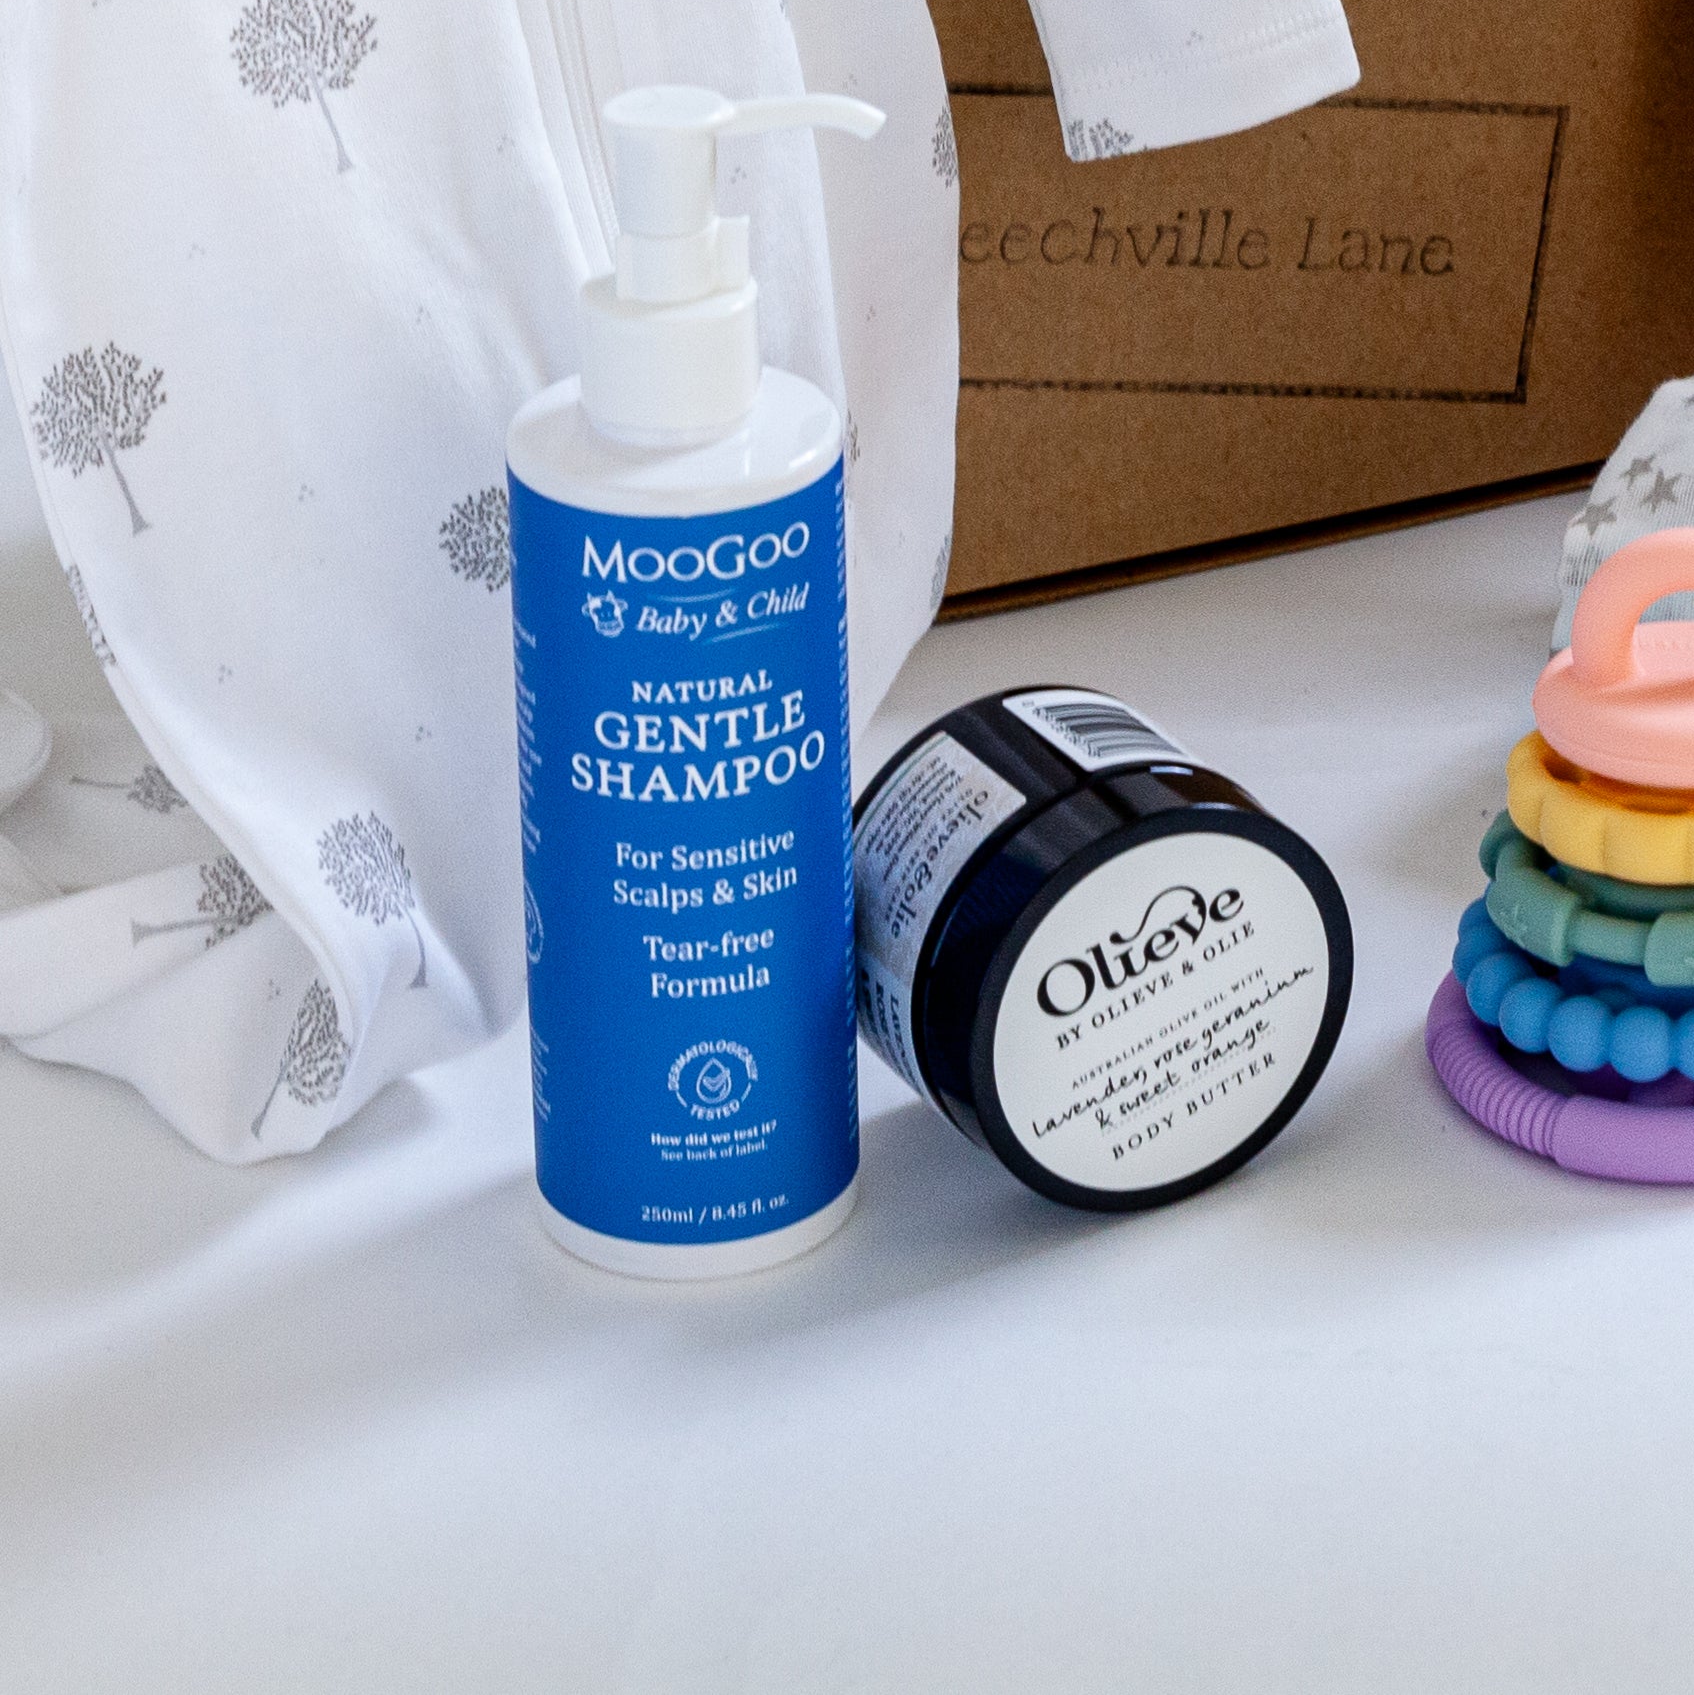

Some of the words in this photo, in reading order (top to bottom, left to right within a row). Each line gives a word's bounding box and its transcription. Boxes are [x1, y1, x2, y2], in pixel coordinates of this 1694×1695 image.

[959, 207, 1271, 272] eechville
[1296, 214, 1456, 277] Lane
[636, 606, 708, 642] Baby
[715, 600, 740, 628] &
[747, 580, 811, 620] Child
[630, 668, 774, 705] NATURAL
[593, 689, 806, 754] GENTLE
[570, 729, 826, 804] SHAMPOO
[614, 840, 664, 872] For
[670, 829, 796, 872] Sensitive
[612, 878, 704, 915] Scalps
[711, 878, 735, 905] &
[742, 865, 799, 903] Skin
[642, 927, 776, 964] Tear-free
[1036, 884, 1245, 1019] Olieve
[649, 963, 771, 1000] Formula
[1056, 1023, 1082, 1051] BY
[1091, 970, 1174, 1030] OLIEVE
[1181, 959, 1195, 977] &
[1202, 919, 1256, 963] OLIE
[1072, 1034, 1155, 1091] AUSTRALIAN
[1158, 1009, 1200, 1039] OLIVE
[1203, 993, 1227, 1011] OIL
[1230, 966, 1265, 994] WITH
[1153, 1036, 1199, 1070] rose
[1201, 964, 1315, 1051] geranium
[1094, 1106, 1114, 1131] &
[1119, 1070, 1181, 1116] sweet
[1190, 1016, 1271, 1075] orange
[650, 1132, 682, 1147] How
[684, 1132, 708, 1147] did
[710, 1132, 732, 1145] we
[733, 1126, 759, 1142] test
[760, 1118, 778, 1136] it?
[689, 1098, 741, 1122] TESTED
[1112, 1111, 1176, 1162] BODY
[1186, 1051, 1276, 1116] BUTTER
[660, 1149, 684, 1162] See
[685, 1147, 718, 1162] back
[719, 1144, 735, 1159] of
[640, 1204, 694, 1224] 250ml
[697, 1205, 708, 1226] /
[711, 1200, 748, 1222] 8.45
